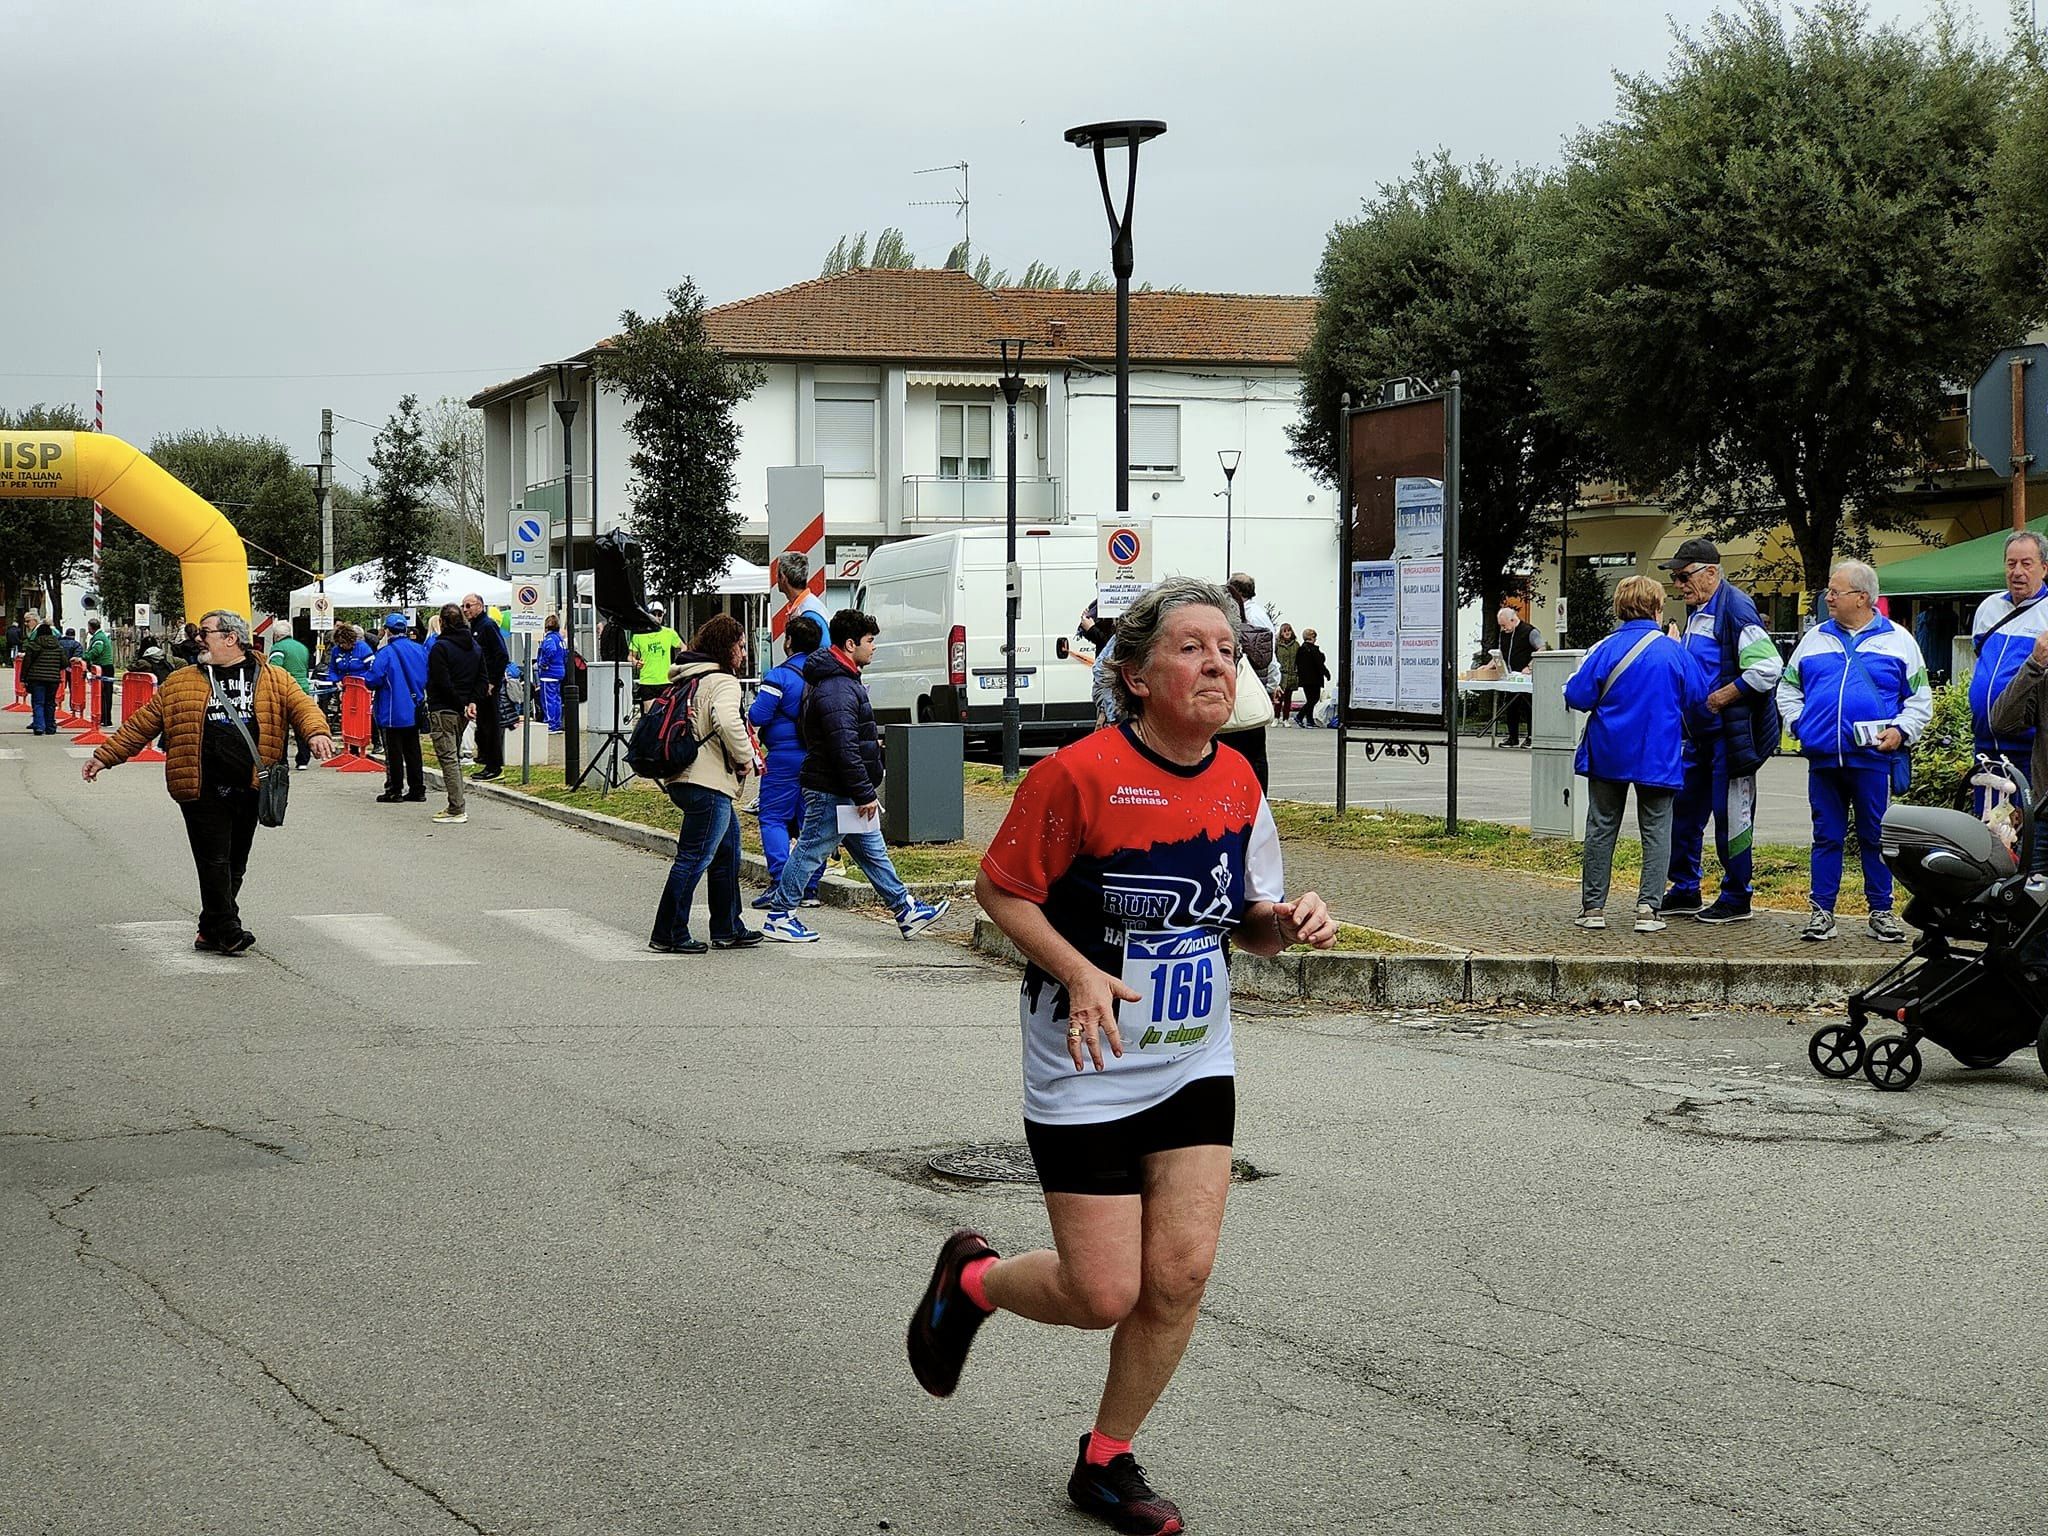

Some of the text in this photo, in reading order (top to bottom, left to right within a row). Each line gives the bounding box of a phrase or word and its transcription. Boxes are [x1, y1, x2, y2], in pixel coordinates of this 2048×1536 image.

[2, 442, 62, 469] ISP
[19, 471, 62, 480] ITALIANA
[1397, 506, 1441, 527] Ivan Alvisi
[1356, 655, 1393, 667] ALVISI IVAN
[1116, 785, 1161, 797] Atletica
[1109, 794, 1169, 806] Castenaso
[1102, 890, 1169, 918] RUN
[1121, 918, 1148, 931] TO
[1150, 957, 1213, 1023] 166
